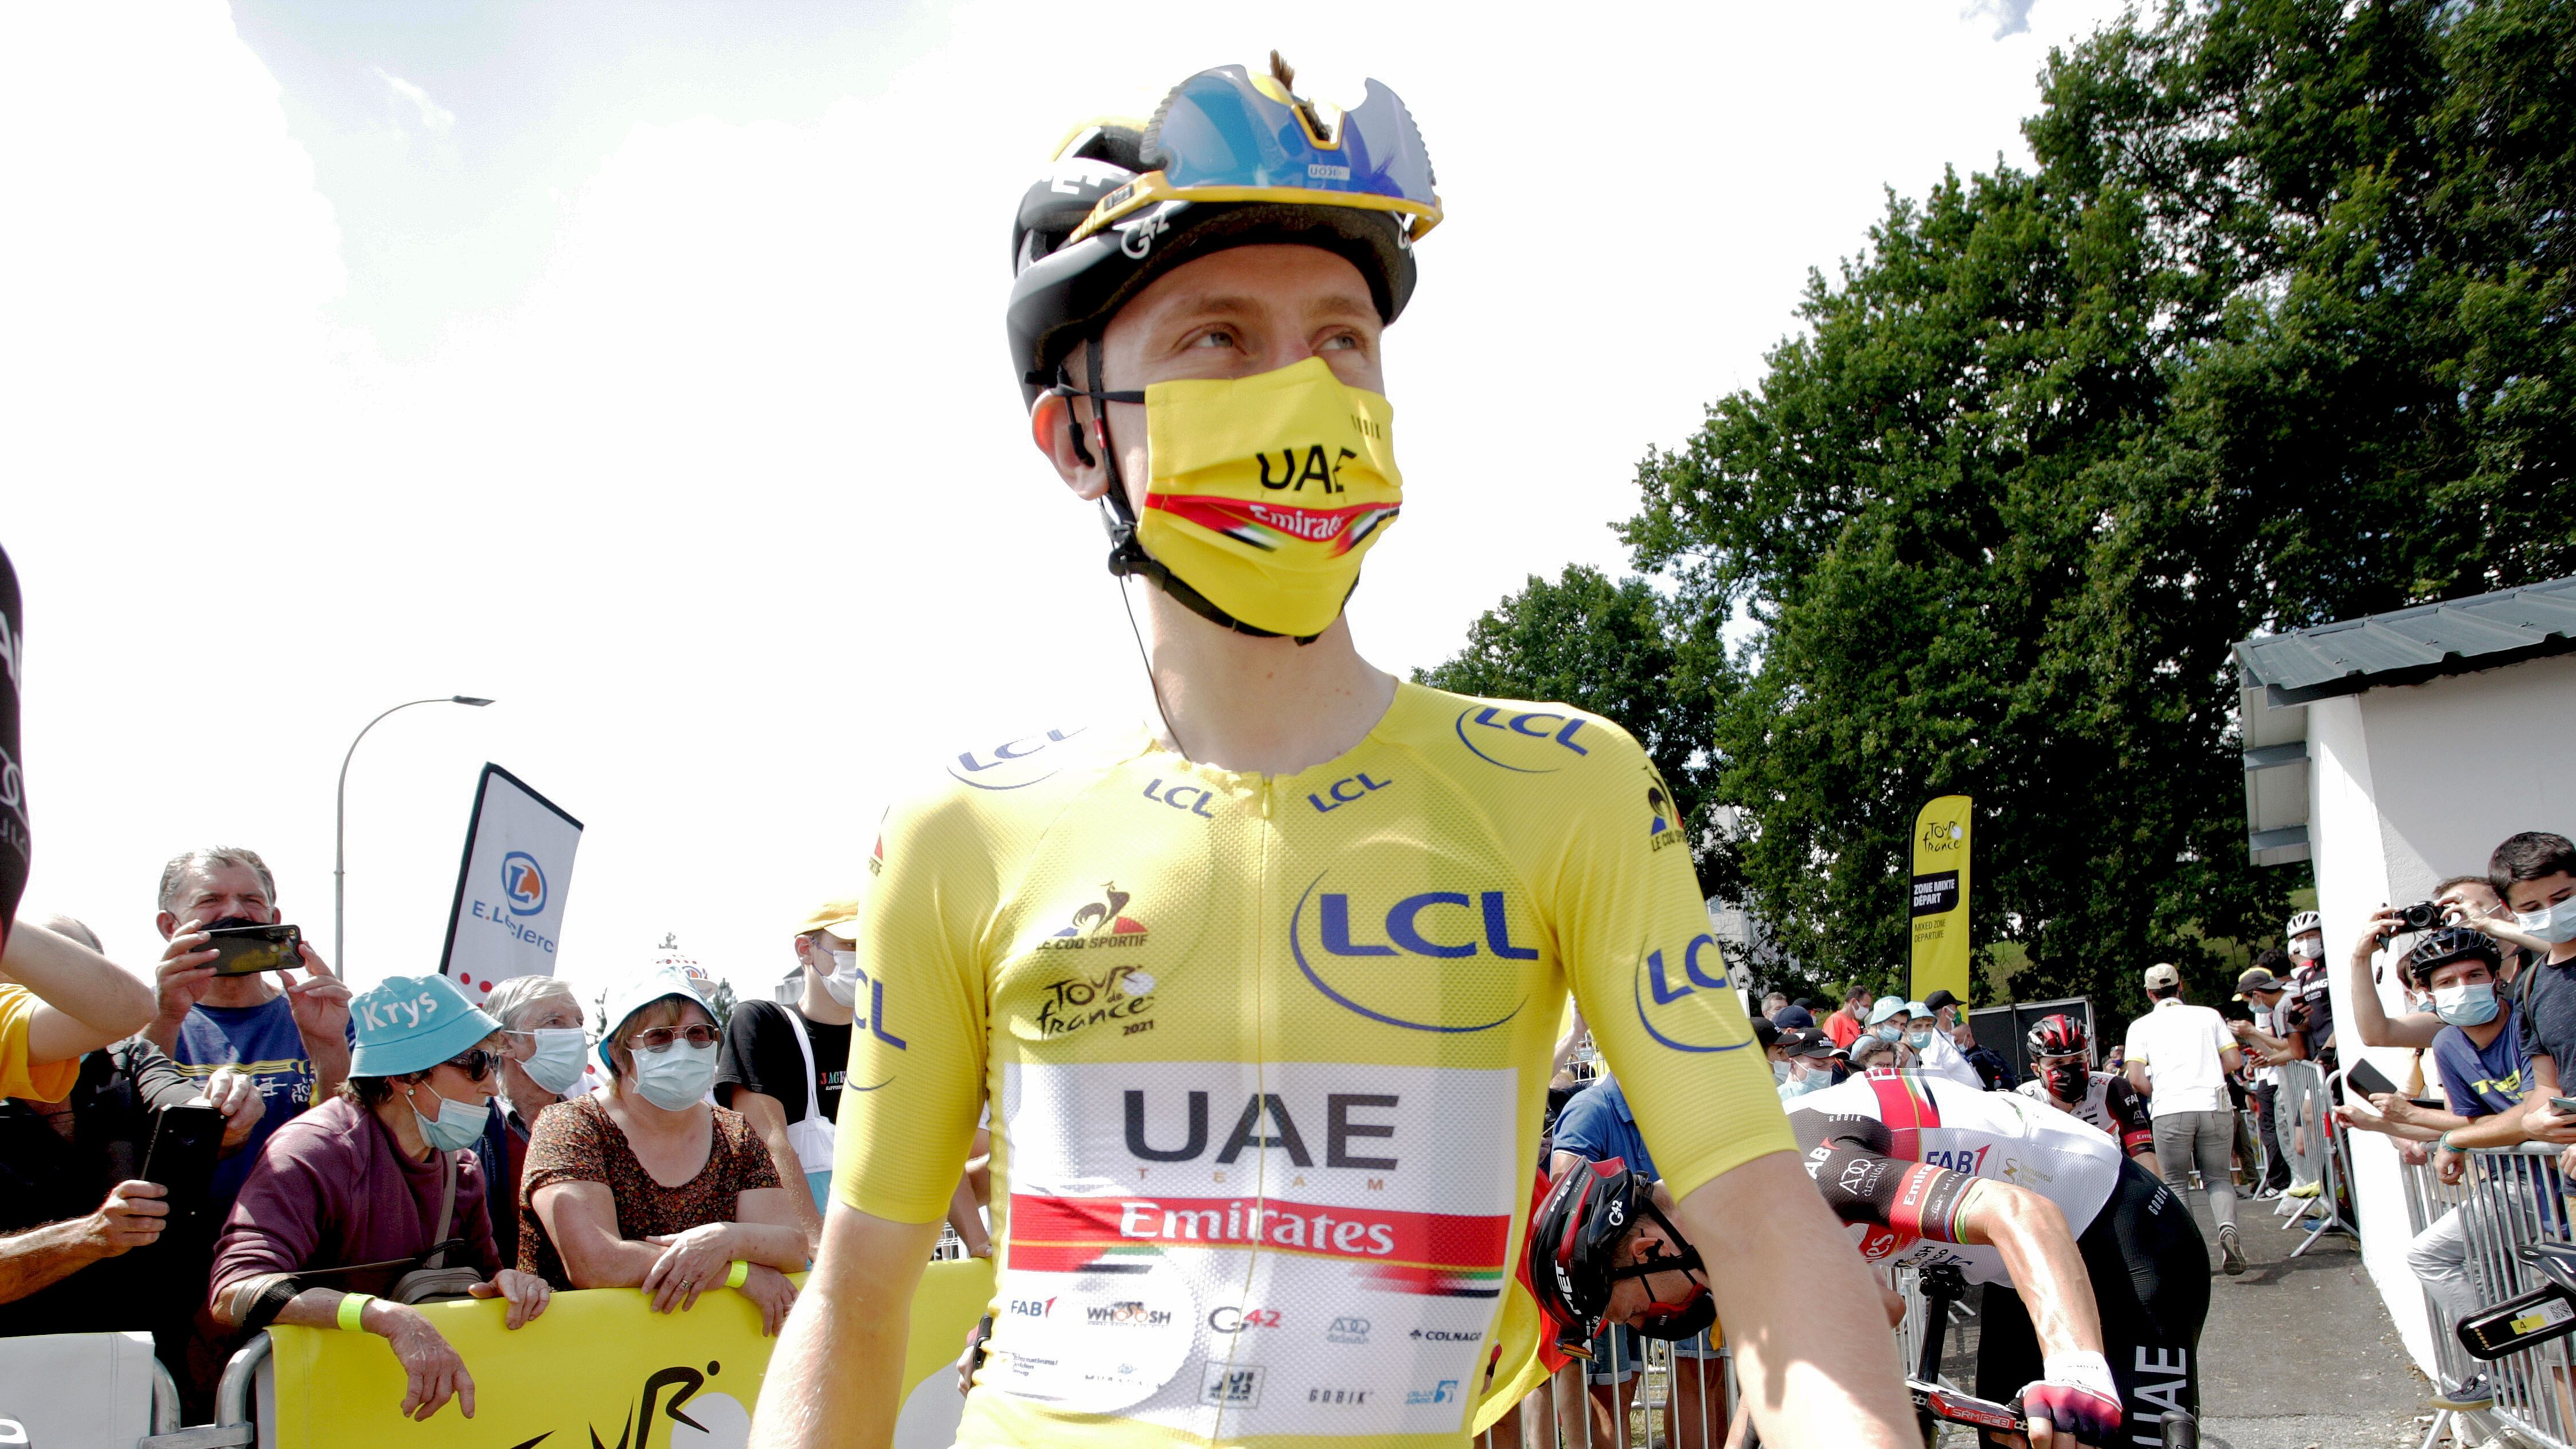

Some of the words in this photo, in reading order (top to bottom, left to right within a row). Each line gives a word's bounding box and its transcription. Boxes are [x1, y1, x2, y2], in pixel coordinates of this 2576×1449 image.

[1249, 504, 1344, 539] Emirat
[1475, 708, 1588, 756] LCL
[957, 727, 1088, 772] LCL
[1143, 778, 1214, 818] LCL
[1308, 772, 1392, 813] LCL
[1914, 882, 1933, 895] ZONE
[1934, 878, 1955, 892] MIXTE
[1089, 934, 1148, 949] SPORTIF
[1320, 891, 1539, 960] LCL
[1914, 920, 1933, 932] MIXED
[1934, 919, 1946, 928] ZONE
[1914, 929, 1944, 943] DEPARTURE
[1647, 934, 1727, 1005] LC
[359, 990, 440, 1032] Krys
[852, 967, 906, 1050] CL
[1107, 993, 1124, 1003] de
[1123, 1020, 1154, 1036] 2021
[2089, 1075, 2109, 1088] G42
[1124, 1089, 1400, 1170] UAE
[1138, 1168, 1383, 1190] TEAM
[1804, 1147, 1832, 1180] AB
[1839, 1159, 1874, 1195] ADQ
[1119, 1201, 1395, 1255] Emirates
[1608, 1200, 1624, 1226] G42
[1555, 1259, 1582, 1315] MET
[1208, 1306, 1281, 1334] G42
[1310, 1389, 1366, 1404] GOBIK
[1952, 1408, 1980, 1421] SRM
